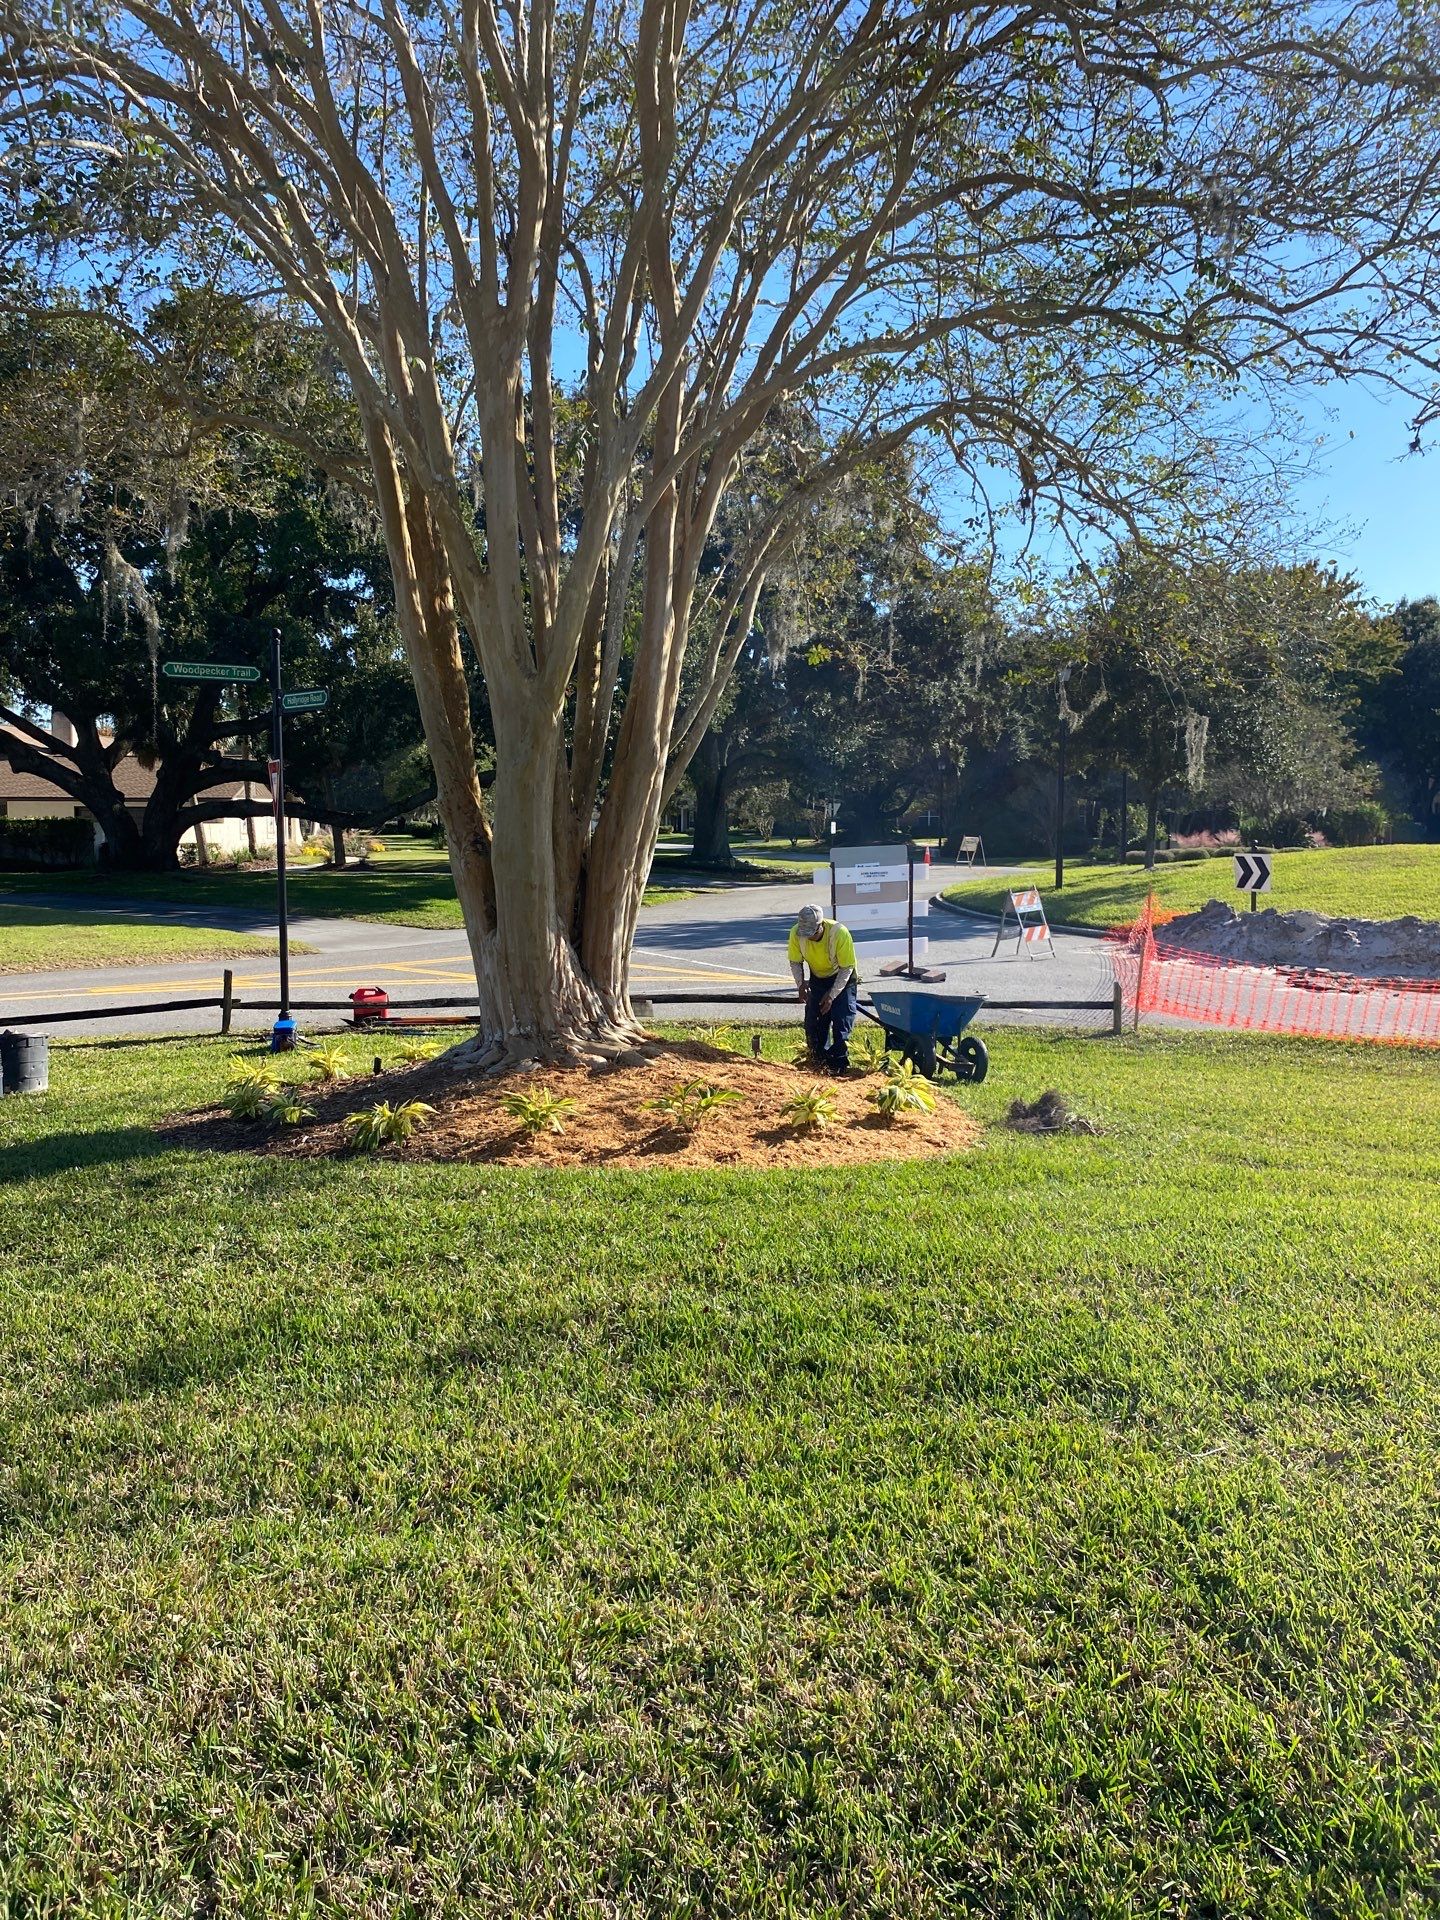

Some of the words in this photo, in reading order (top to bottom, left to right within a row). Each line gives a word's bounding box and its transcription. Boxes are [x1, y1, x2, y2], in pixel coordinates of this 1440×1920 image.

[173, 664, 230, 676] Woodpecker
[231, 667, 251, 677] Trail
[310, 693, 323, 703] Road
